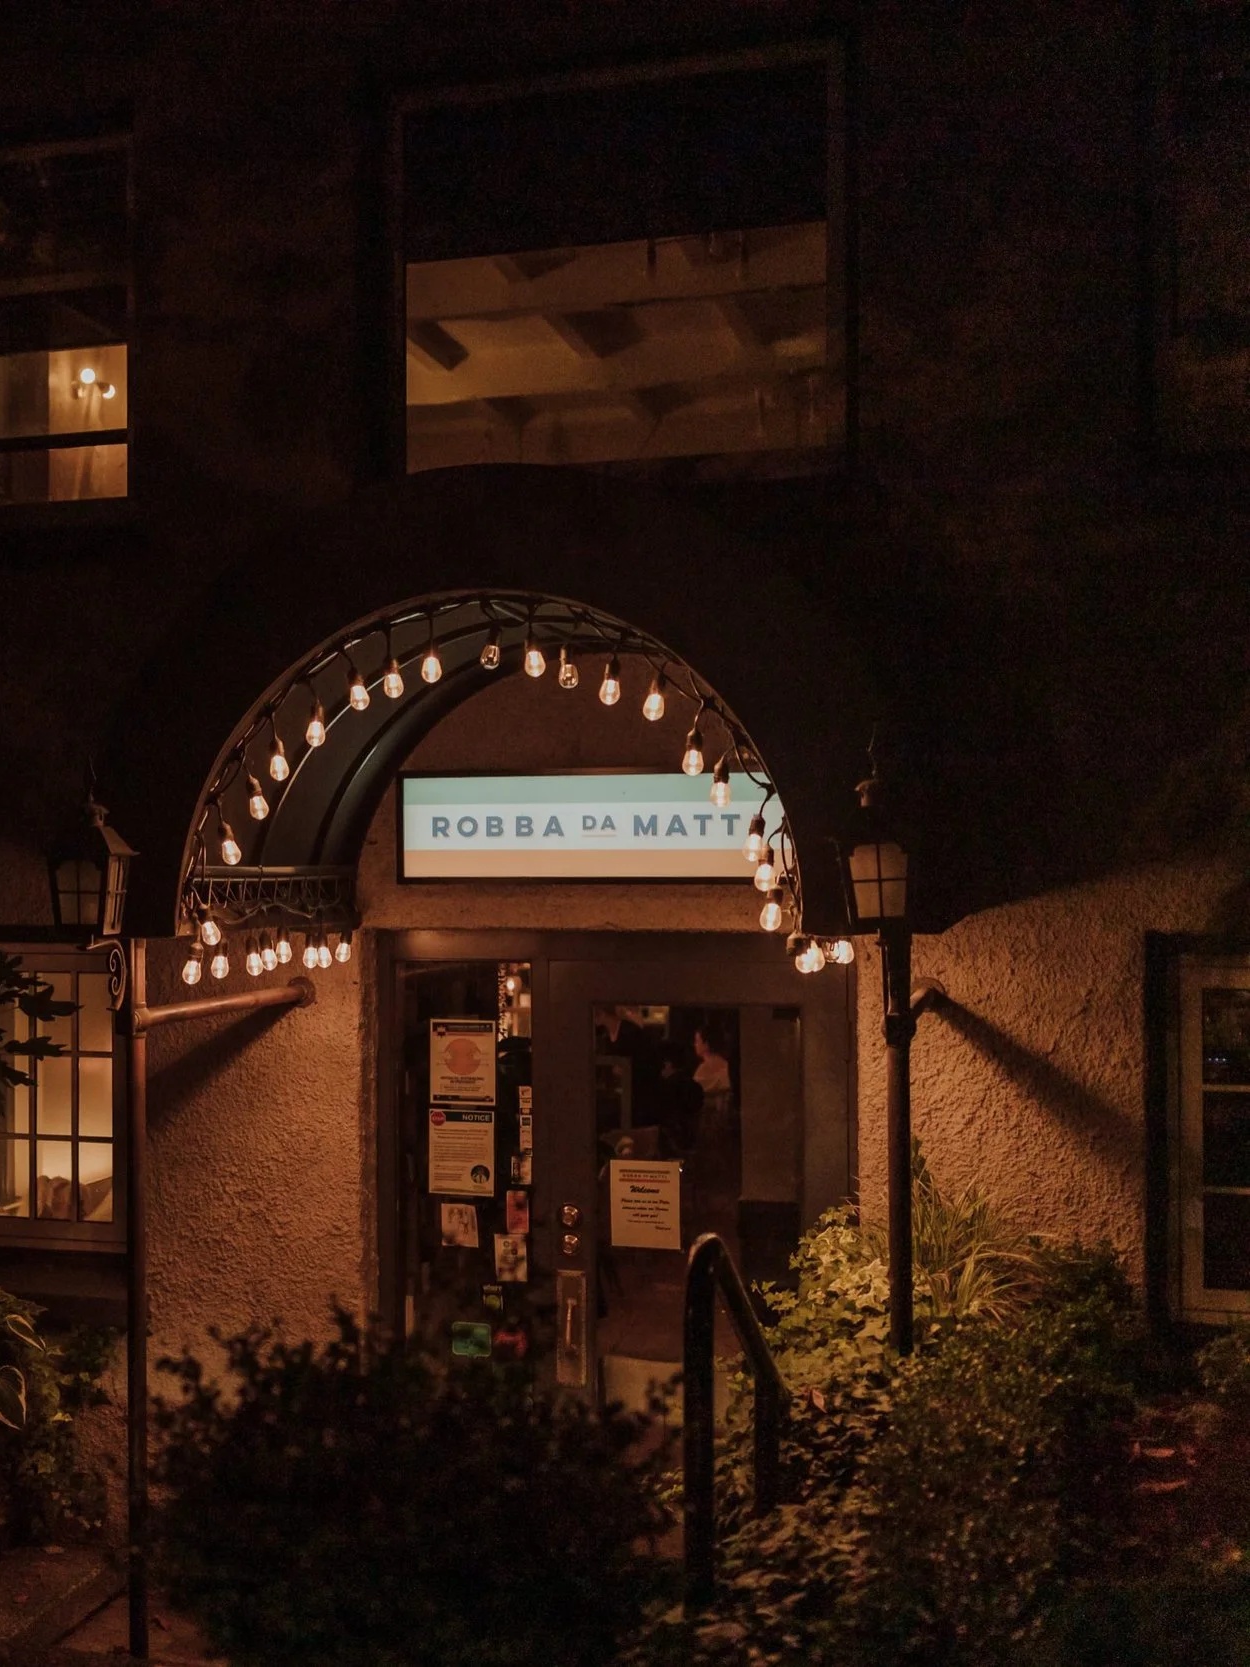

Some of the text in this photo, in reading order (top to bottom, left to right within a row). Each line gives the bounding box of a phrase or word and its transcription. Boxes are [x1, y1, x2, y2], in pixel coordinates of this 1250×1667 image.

[432, 813, 758, 837] ROBBA DA MATT
[462, 1114, 491, 1122] NOTICE
